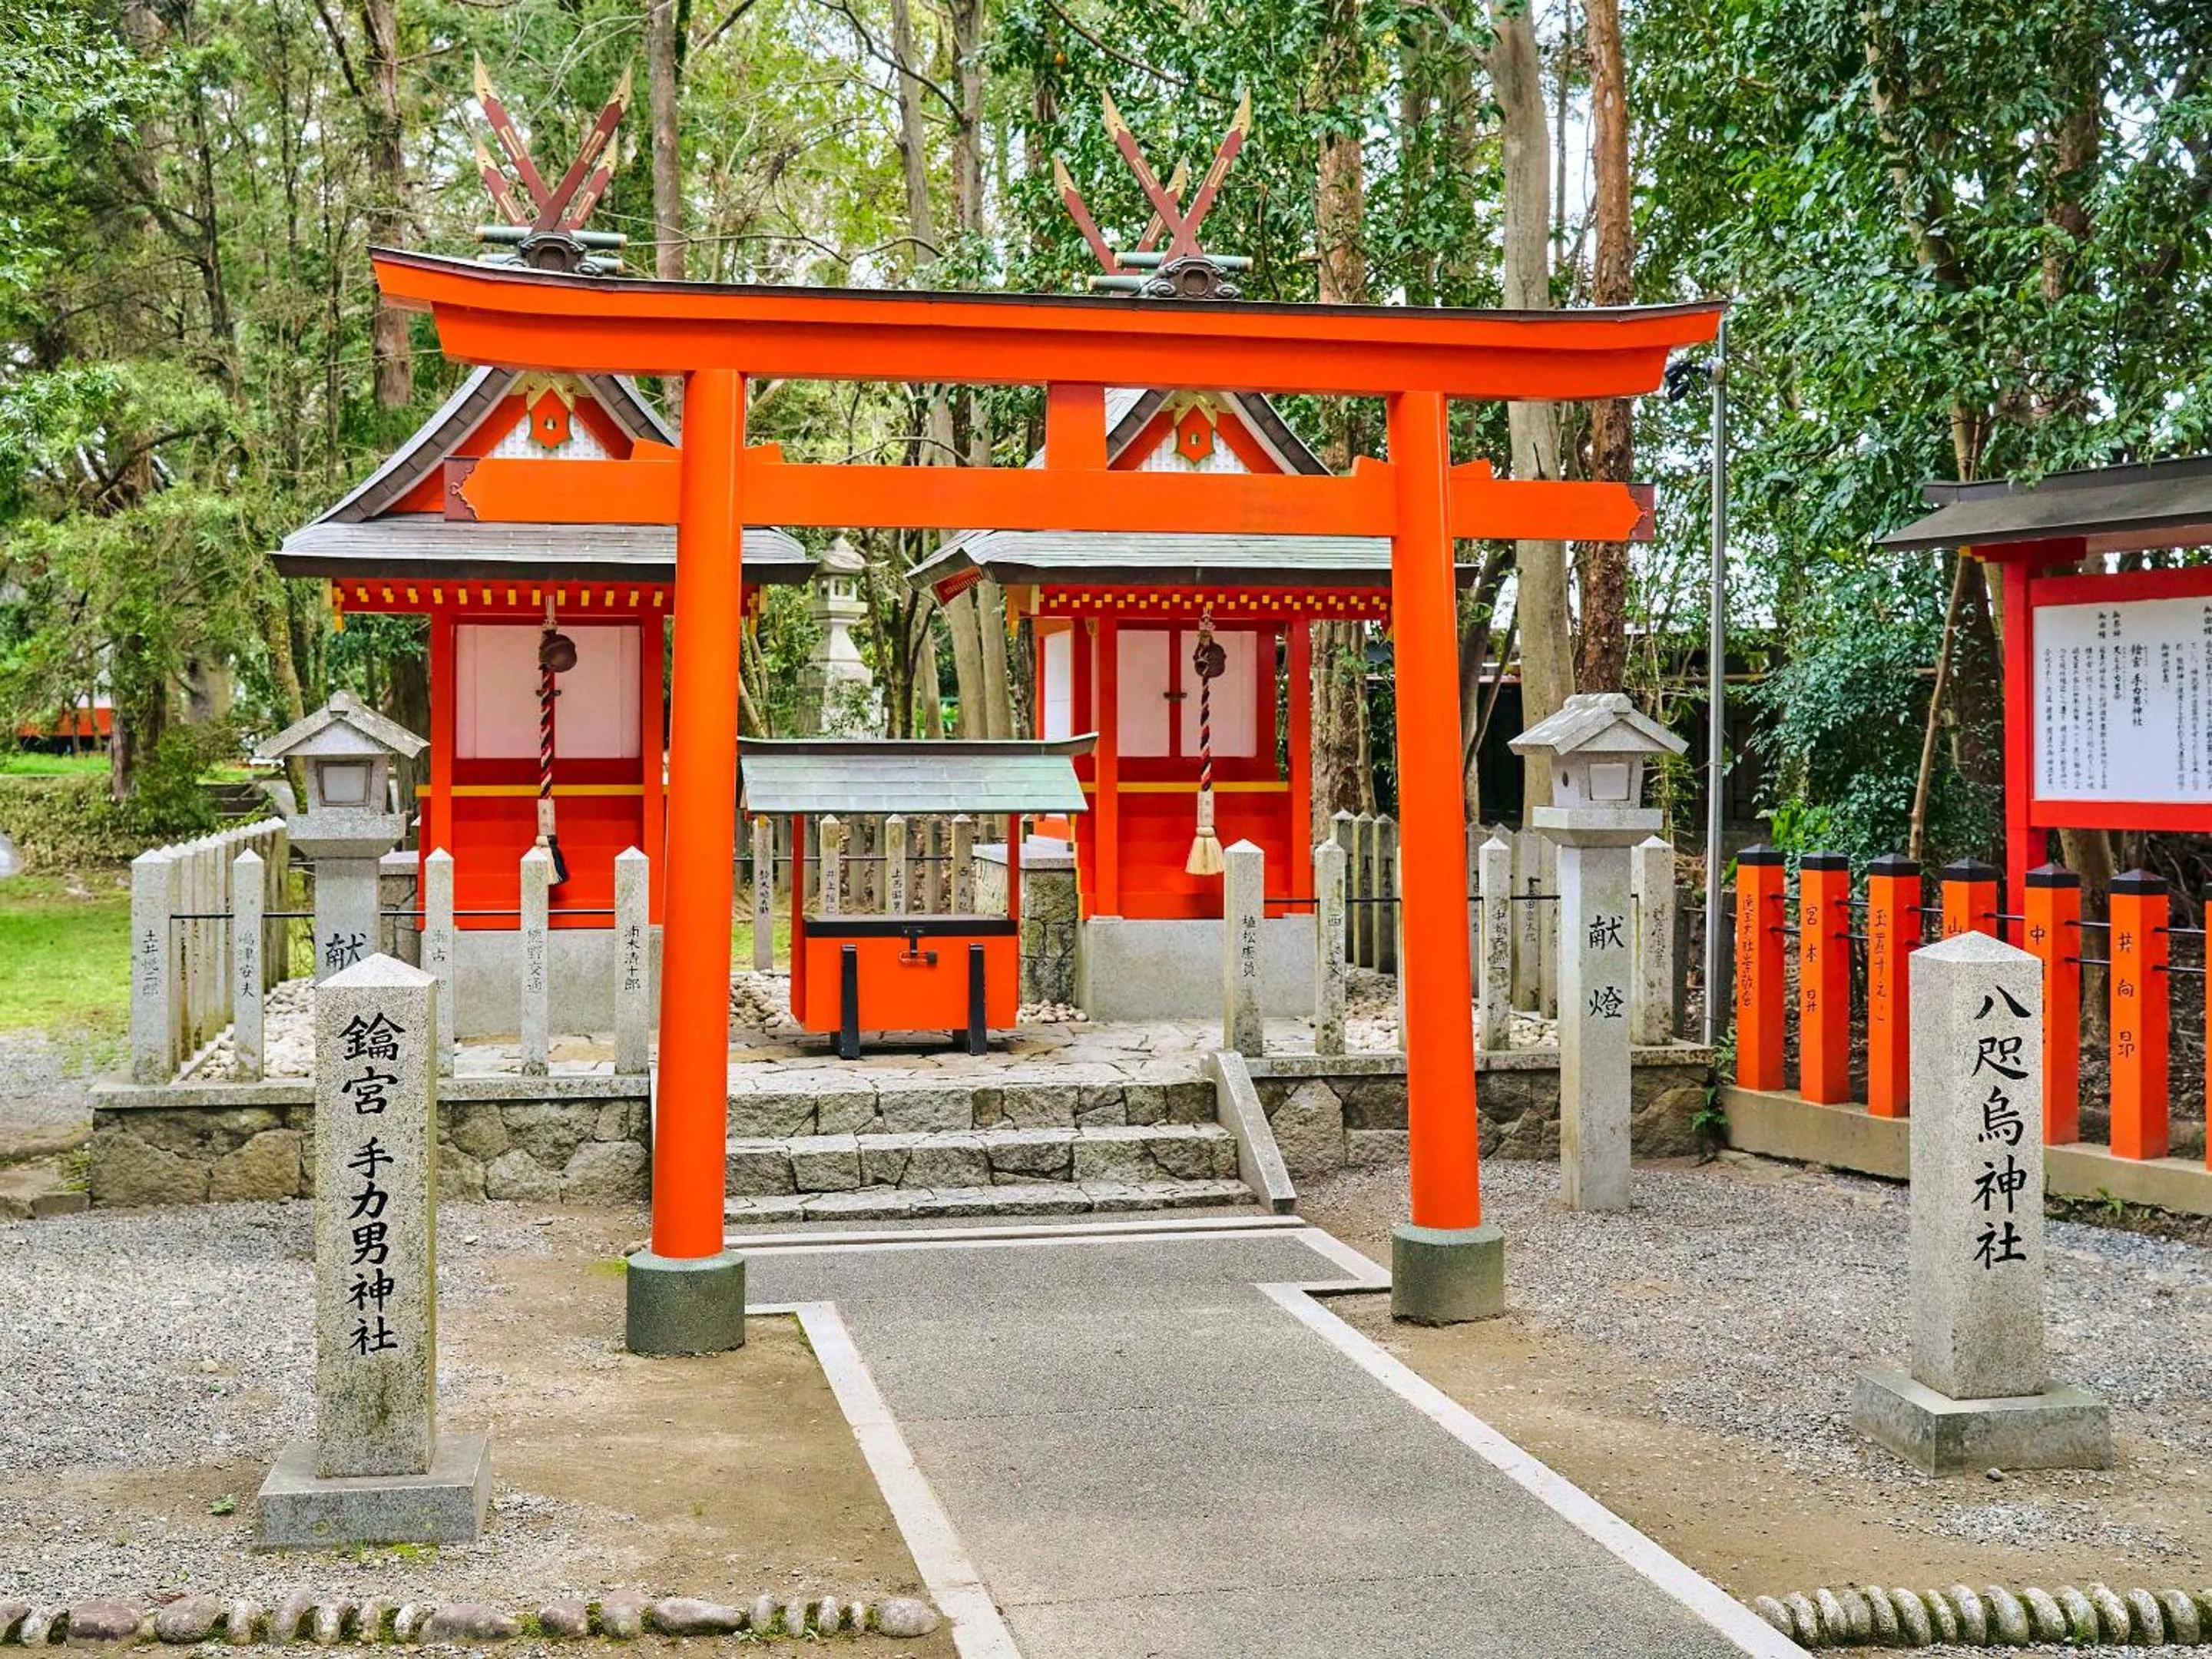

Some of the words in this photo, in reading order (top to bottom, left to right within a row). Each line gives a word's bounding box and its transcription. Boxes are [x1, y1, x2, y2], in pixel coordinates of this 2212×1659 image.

[1588, 915, 1624, 1018] 献燈
[1971, 985, 2032, 1270] 八咫烏神社
[347, 1137, 399, 1356] 手力男神社
